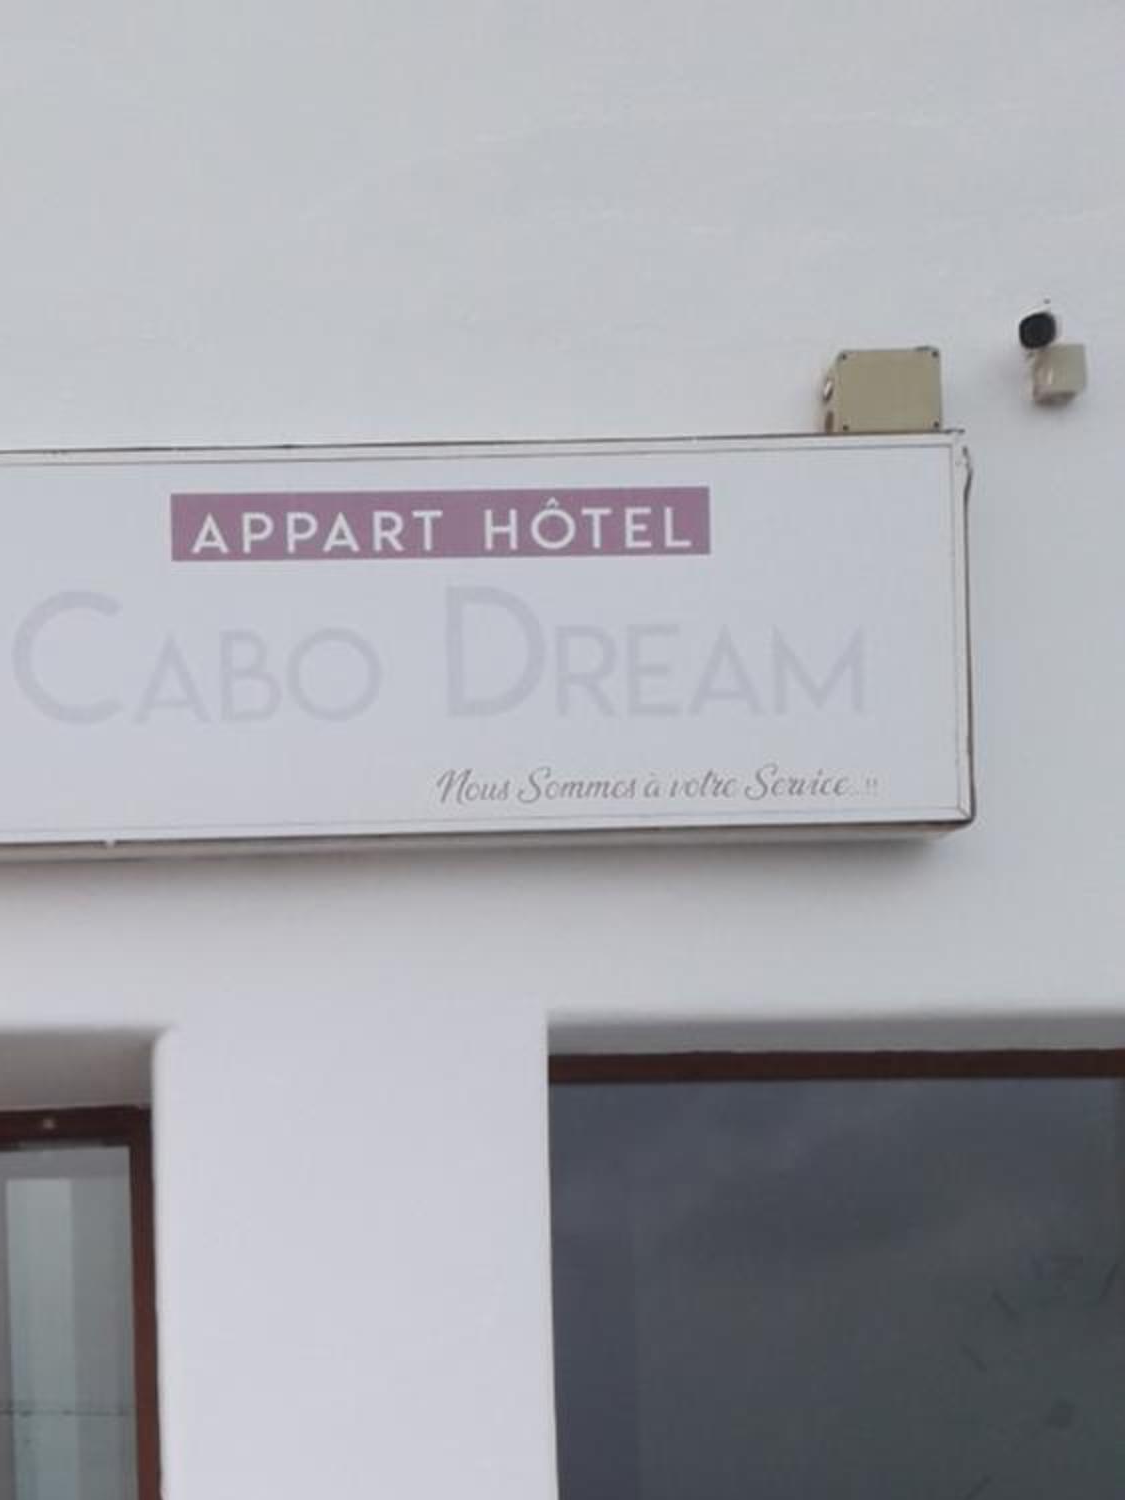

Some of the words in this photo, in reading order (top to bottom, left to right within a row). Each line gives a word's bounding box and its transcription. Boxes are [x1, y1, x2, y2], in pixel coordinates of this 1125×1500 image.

[191, 509, 444, 555] APPART
[483, 496, 693, 551] HÔTEL
[13, 589, 382, 725] CABO
[447, 584, 868, 717] DREAM
[436, 768, 510, 803] Nous
[517, 765, 637, 804] Sommes
[642, 771, 661, 800] à
[668, 768, 738, 800] votre
